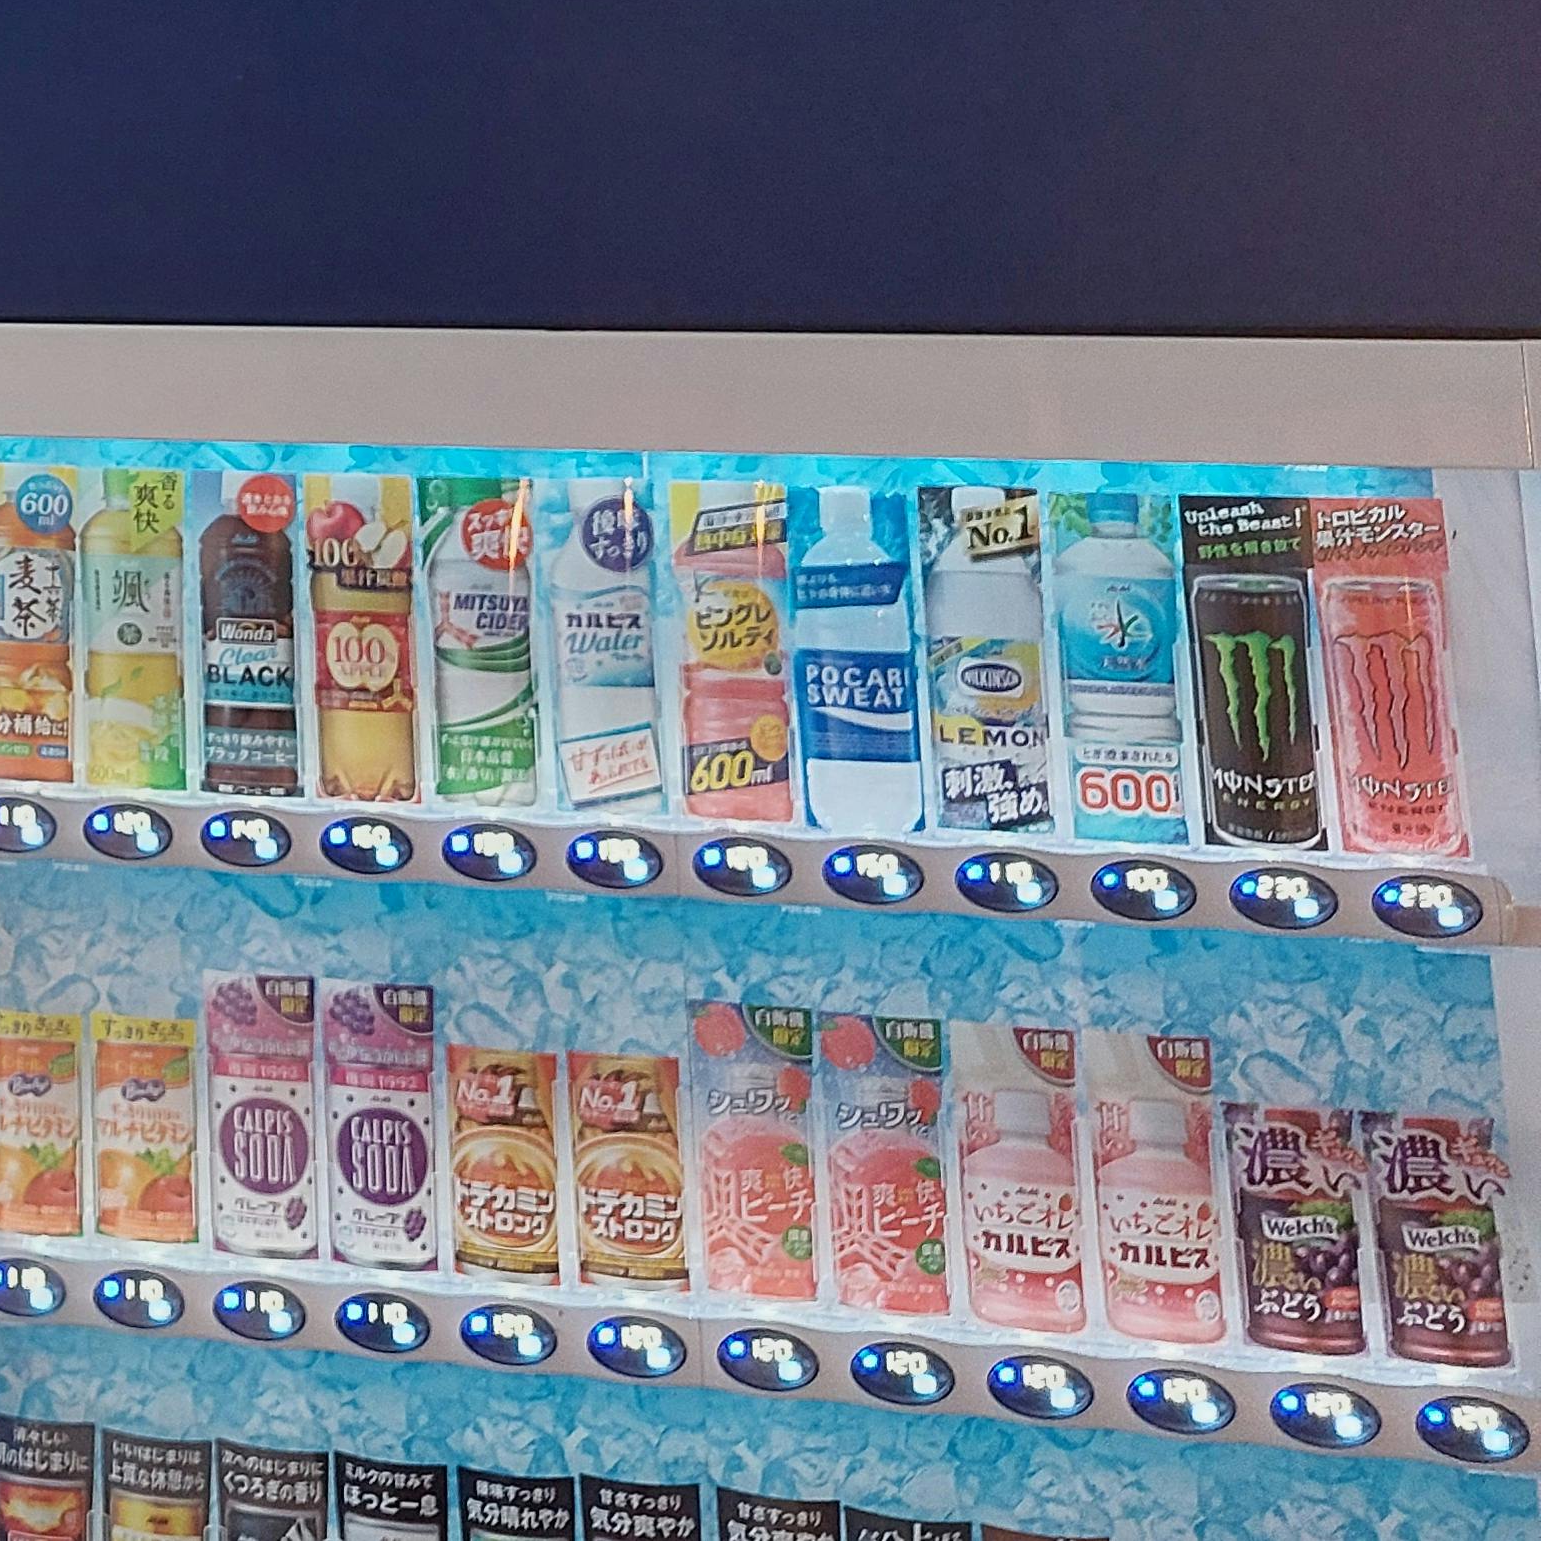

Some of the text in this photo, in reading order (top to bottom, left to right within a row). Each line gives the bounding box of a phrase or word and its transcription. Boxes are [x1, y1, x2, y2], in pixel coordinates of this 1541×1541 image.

[19, 493, 69, 516] 600
[133, 483, 160, 535] 爽快
[1184, 501, 1265, 525] Unleash
[1317, 505, 1406, 530] トロピカル
[967, 504, 1034, 550] No.1
[1198, 507, 1302, 537] the Beast!
[9, 555, 47, 637] 麦茶
[219, 622, 274, 642] Wonda
[565, 613, 643, 629] カルピス
[333, 636, 386, 664] 100
[566, 631, 644, 653] Water
[699, 626, 775, 652] ソルティ
[206, 665, 293, 687] BLACK
[806, 664, 910, 688] POCARI
[807, 683, 904, 708] SWEAT
[938, 725, 1046, 748] LEMON
[1079, 769, 1173, 814] 600
[458, 1075, 513, 1105] No.1
[580, 1081, 639, 1111] No.1
[233, 1106, 293, 1135] CALPIS
[350, 1117, 411, 1145] CALPIS
[233, 1131, 297, 1184] SODA
[351, 1141, 416, 1196] SODA
[741, 1190, 813, 1223] ピーチ
[873, 1201, 945, 1238] ピーチ
[973, 1201, 1073, 1231] いちごオレ
[466, 1207, 548, 1236] ストロング
[592, 1215, 677, 1242] ストロング
[1109, 1211, 1213, 1240] いちごオレ
[1266, 1216, 1335, 1237] Welch's
[982, 1230, 1071, 1258] カルピス
[1407, 1229, 1476, 1248] Welch's
[1118, 1242, 1211, 1269] カルピス
[1254, 1288, 1321, 1321] ぶどう
[1396, 1300, 1466, 1334] ぶどう
[108, 1462, 206, 1493] 上質な休憩から
[222, 1475, 322, 1504] くつろぎの香り
[344, 1462, 434, 1490] ミルクの甘みで
[343, 1486, 438, 1518] ほっと一息
[465, 1497, 570, 1530] 気分晴れやか
[599, 1487, 683, 1511] 甘さすっきり
[589, 1505, 697, 1540] 気分爽やか
[737, 1500, 823, 1528] 甘さすっきり
